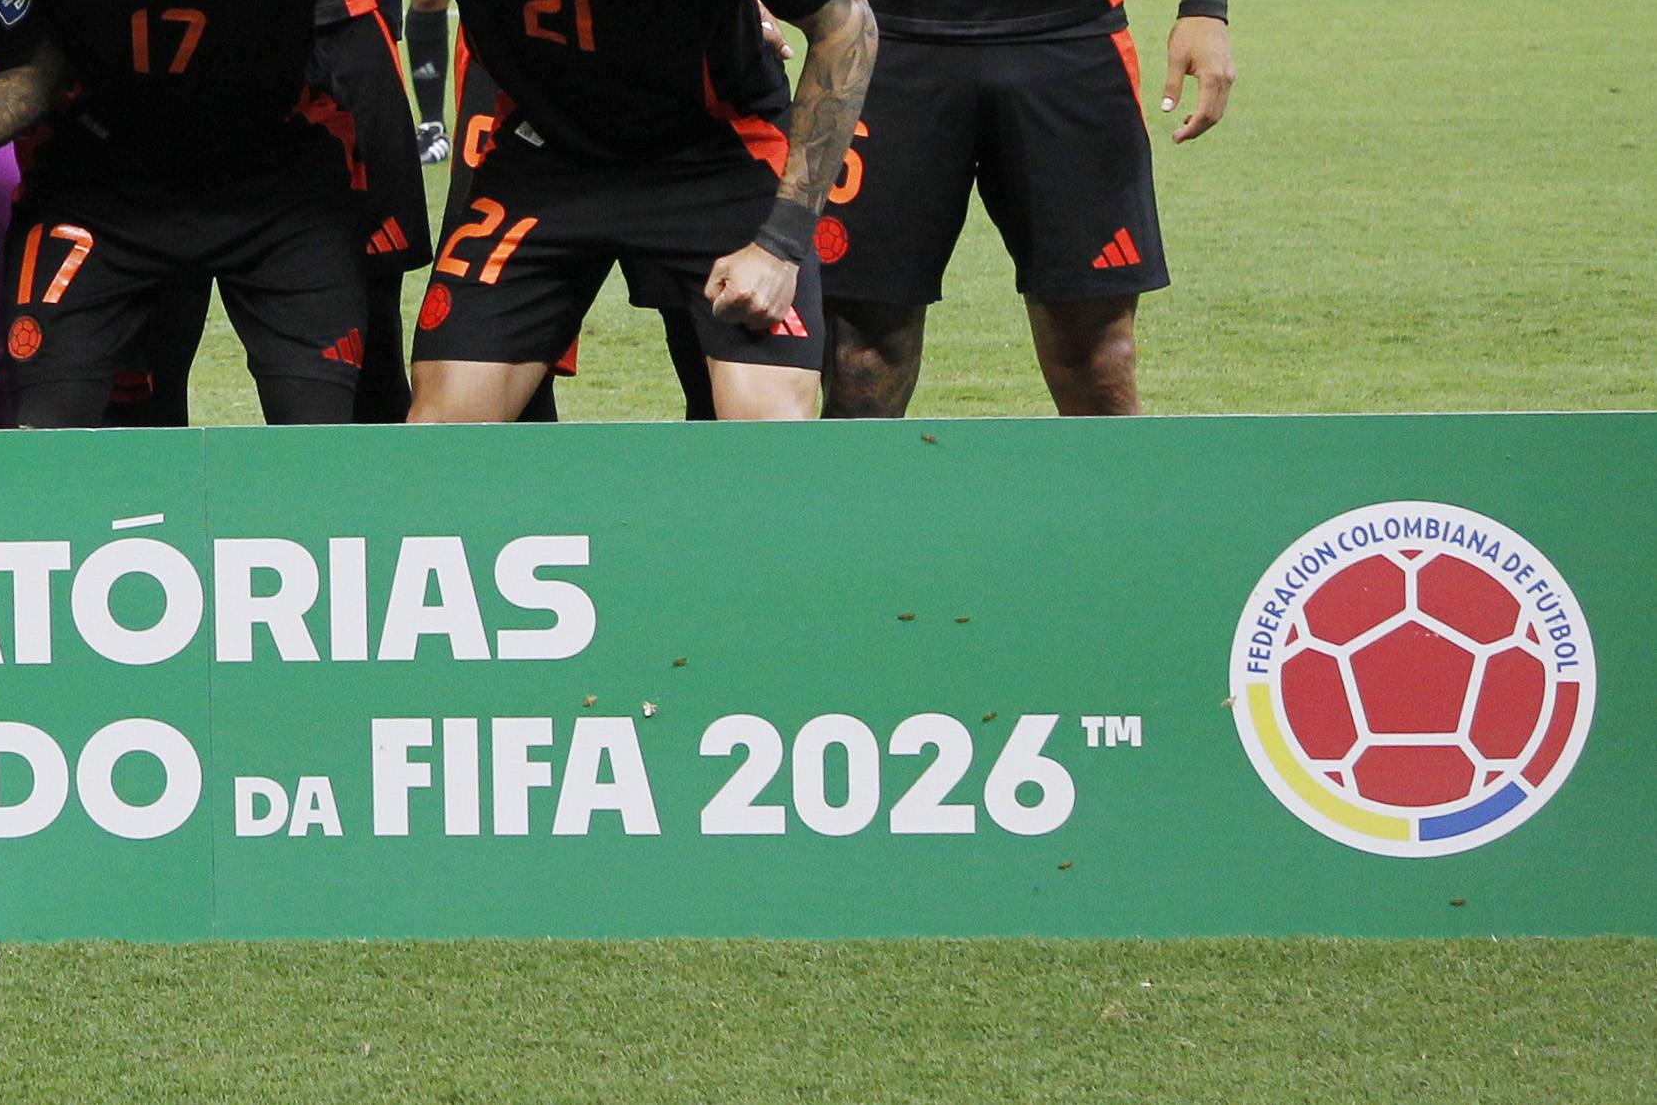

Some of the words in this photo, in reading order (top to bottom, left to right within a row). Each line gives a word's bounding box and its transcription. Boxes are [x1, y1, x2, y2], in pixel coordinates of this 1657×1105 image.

[131, 9, 206, 73] 17
[17, 224, 94, 304] 17
[436, 197, 539, 285] 21
[1337, 516, 1501, 563] COLOMBIANA
[1501, 551, 1535, 585] DE
[1526, 578, 1579, 673] FÚTBOL
[234, 776, 343, 837] DA
[371, 716, 662, 836] FIFA
